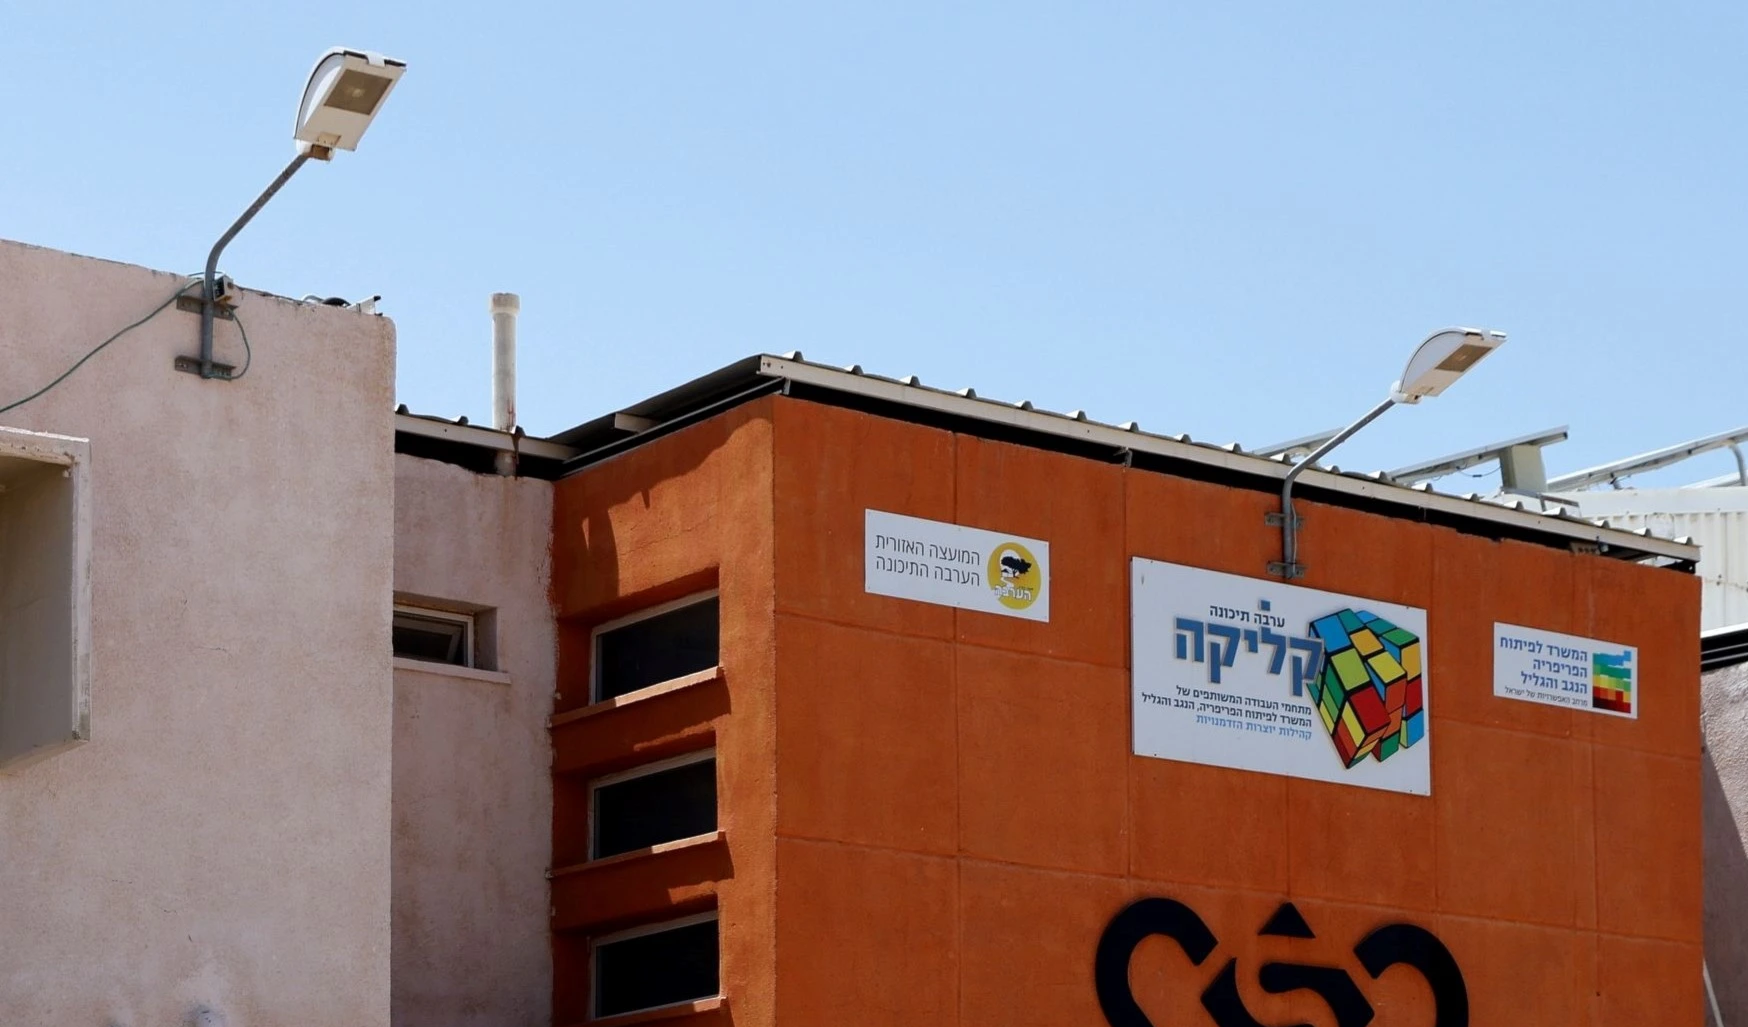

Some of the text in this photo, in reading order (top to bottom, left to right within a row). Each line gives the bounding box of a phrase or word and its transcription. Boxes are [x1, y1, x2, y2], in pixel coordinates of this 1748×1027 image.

[875, 534, 980, 566] המועצה האזורית
[876, 555, 980, 587] הערבה התיכונה
[1210, 605, 1285, 628] ערבה תיכונה
[1175, 600, 1324, 697] קליקה
[1500, 636, 1588, 662] המשרד לפיתוח
[1533, 659, 1588, 678] הפריפריה
[1521, 671, 1588, 695] הנגב והגליל
[1142, 692, 1171, 706] והגליל
[1174, 699, 1195, 710] הנגב
[1176, 685, 1312, 715] מתחמי העבודה המשותפים של
[1196, 714, 1312, 740] קהילות יוצרות הזדמנויות
[1245, 709, 1277, 722] לפיתוח
[1280, 715, 1312, 727] המשרד
